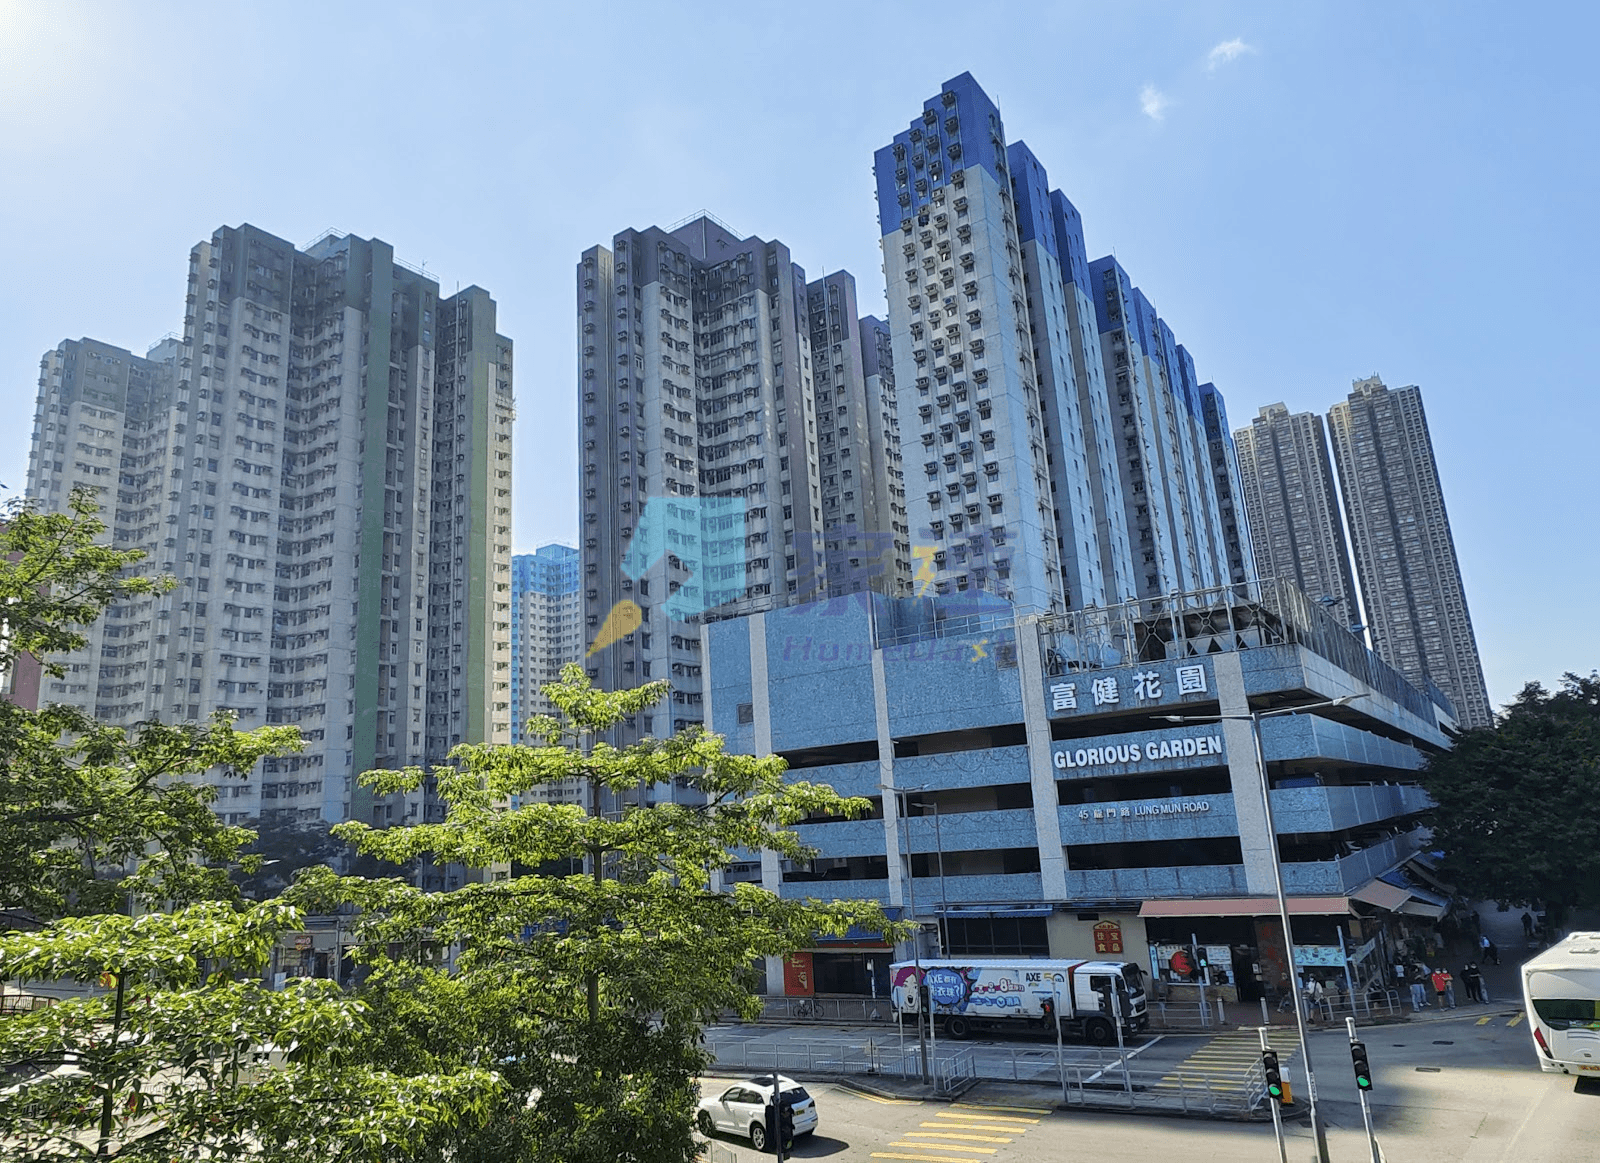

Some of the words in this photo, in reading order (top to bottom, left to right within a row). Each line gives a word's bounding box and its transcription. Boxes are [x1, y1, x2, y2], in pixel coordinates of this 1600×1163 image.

[1050, 664, 1208, 711] 富健花園
[1054, 744, 1141, 769] GLORIOUS
[1145, 735, 1222, 760] GARDEN
[1078, 809, 1089, 820] 45
[1134, 805, 1160, 816] LUNG
[1160, 803, 1182, 814] MUN
[1182, 801, 1210, 812] ROAD
[1026, 972, 1042, 982] AXE
